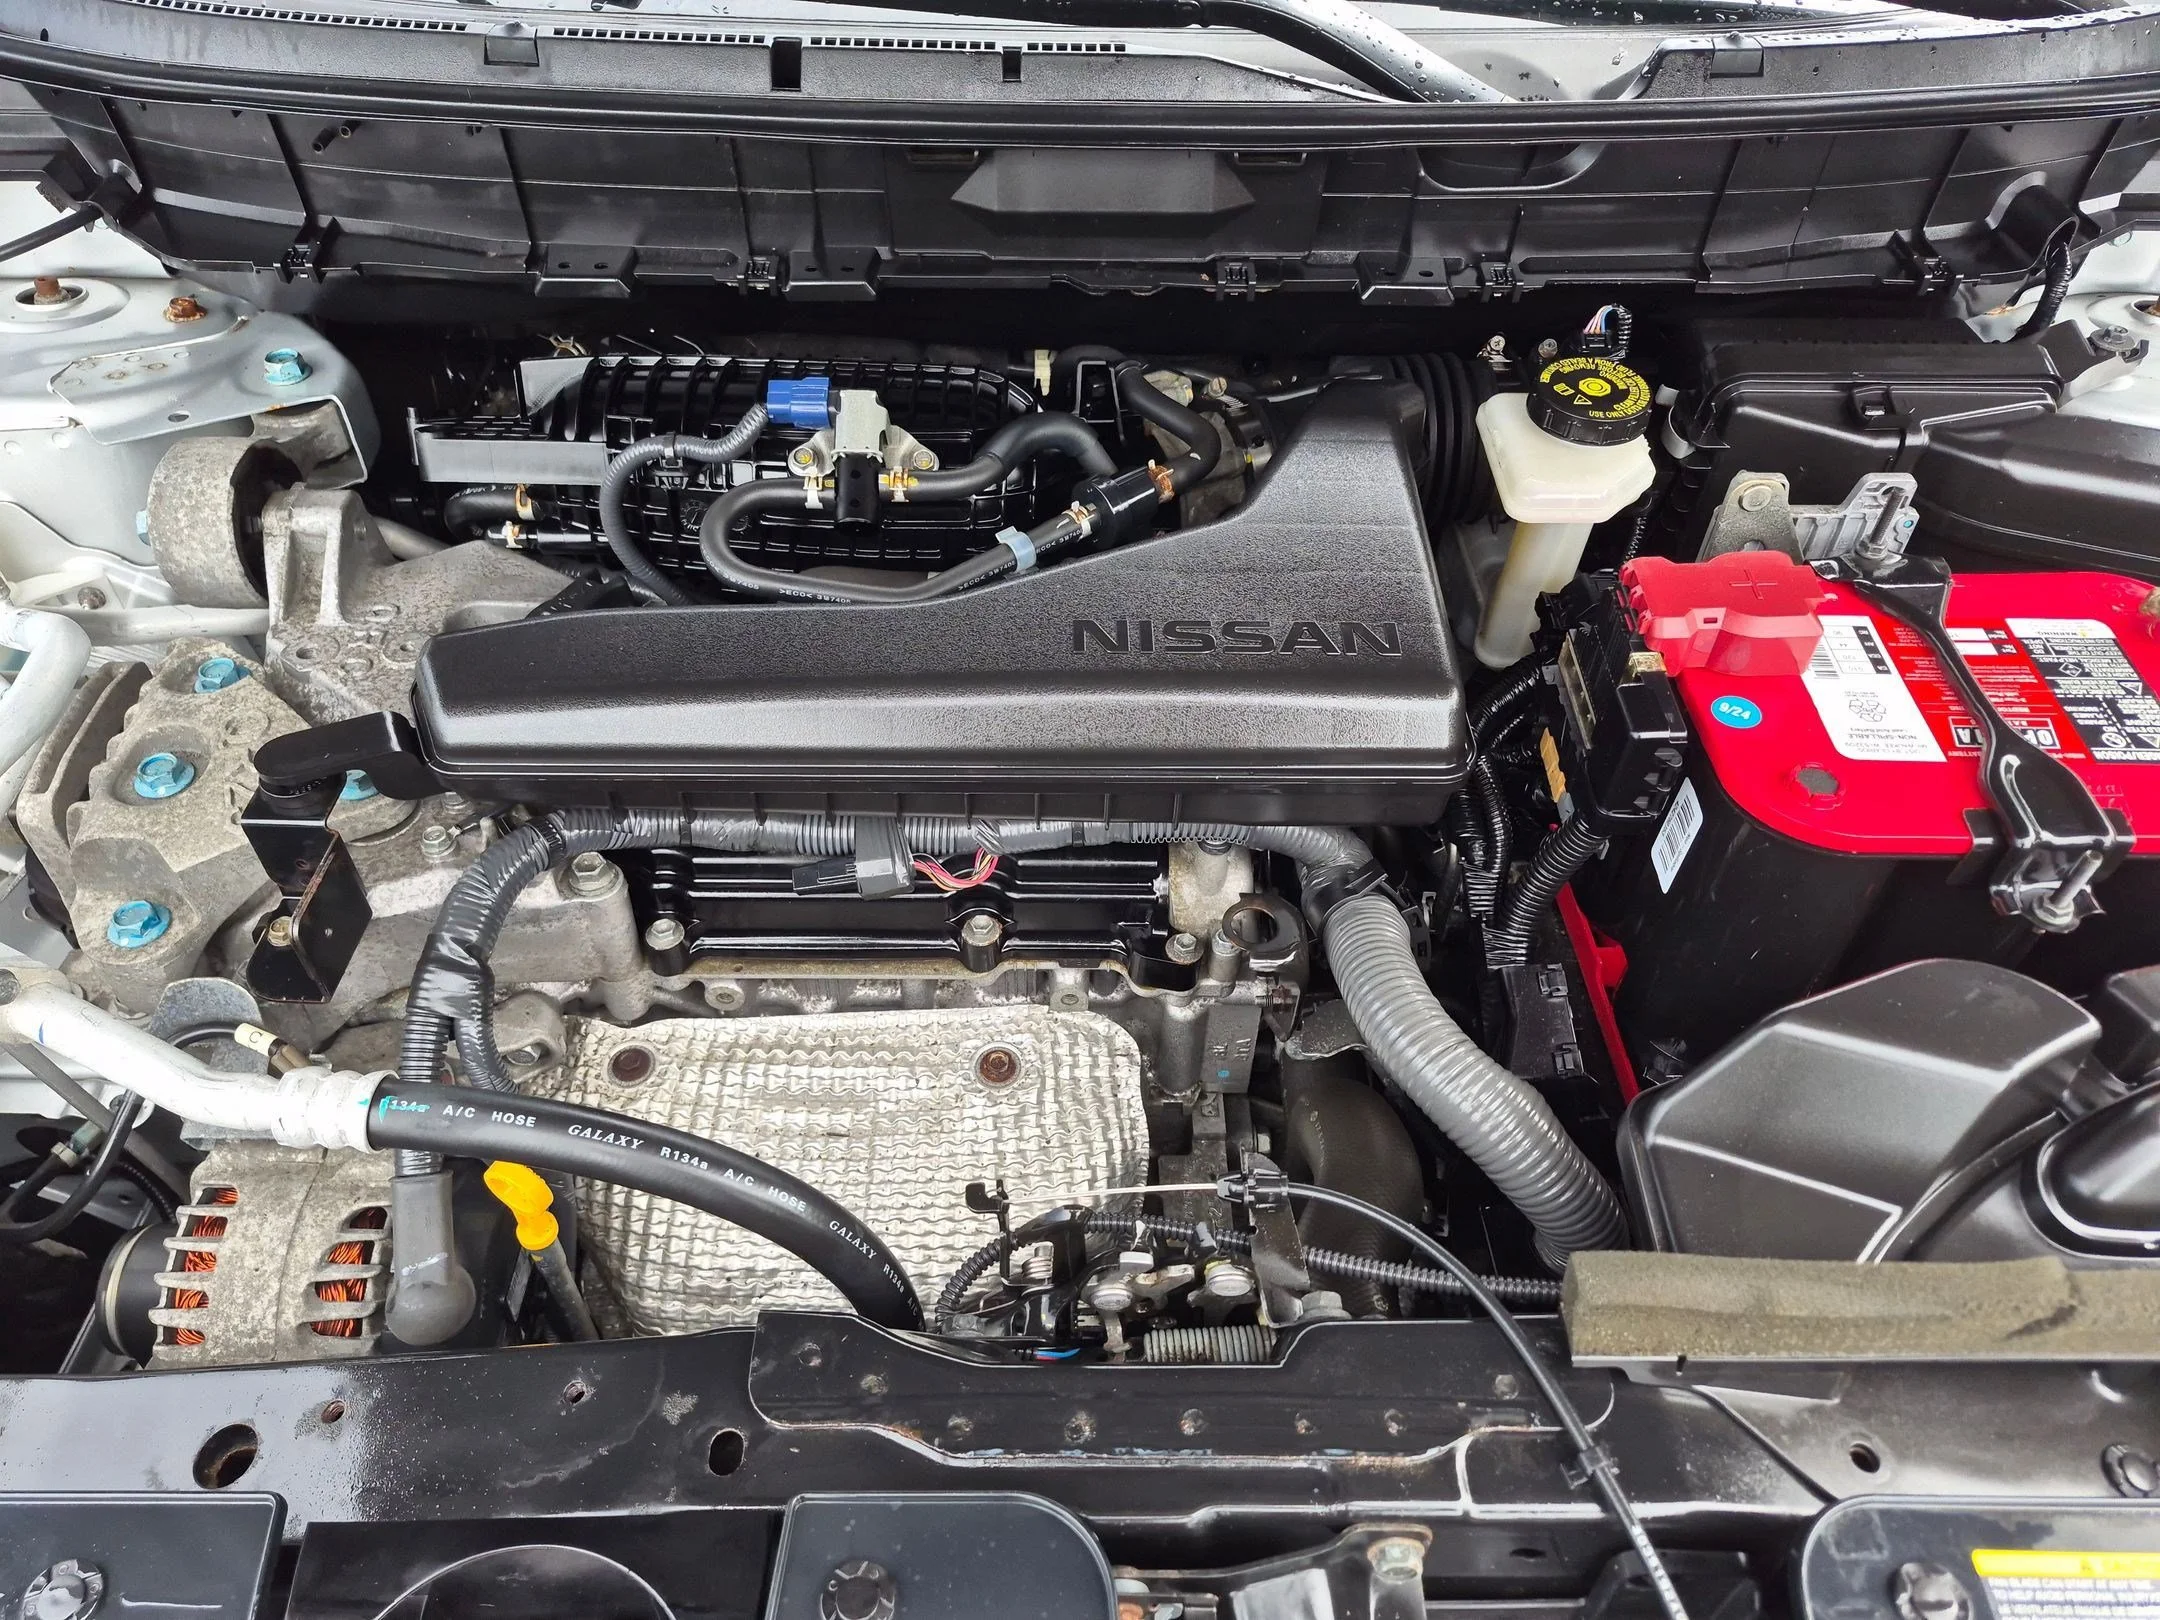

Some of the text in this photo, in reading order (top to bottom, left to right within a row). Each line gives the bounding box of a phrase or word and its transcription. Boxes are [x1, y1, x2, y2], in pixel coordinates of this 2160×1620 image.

[1072, 619, 1403, 656] NISSAN
[442, 1105, 476, 1118] A/C
[491, 1110, 537, 1128] HOSE
[567, 1124, 645, 1151] GALAXY
[660, 1146, 709, 1170] R134a
[723, 1168, 755, 1187] A/C
[767, 1185, 807, 1212] HOSE
[829, 1220, 878, 1260] GALAXY
